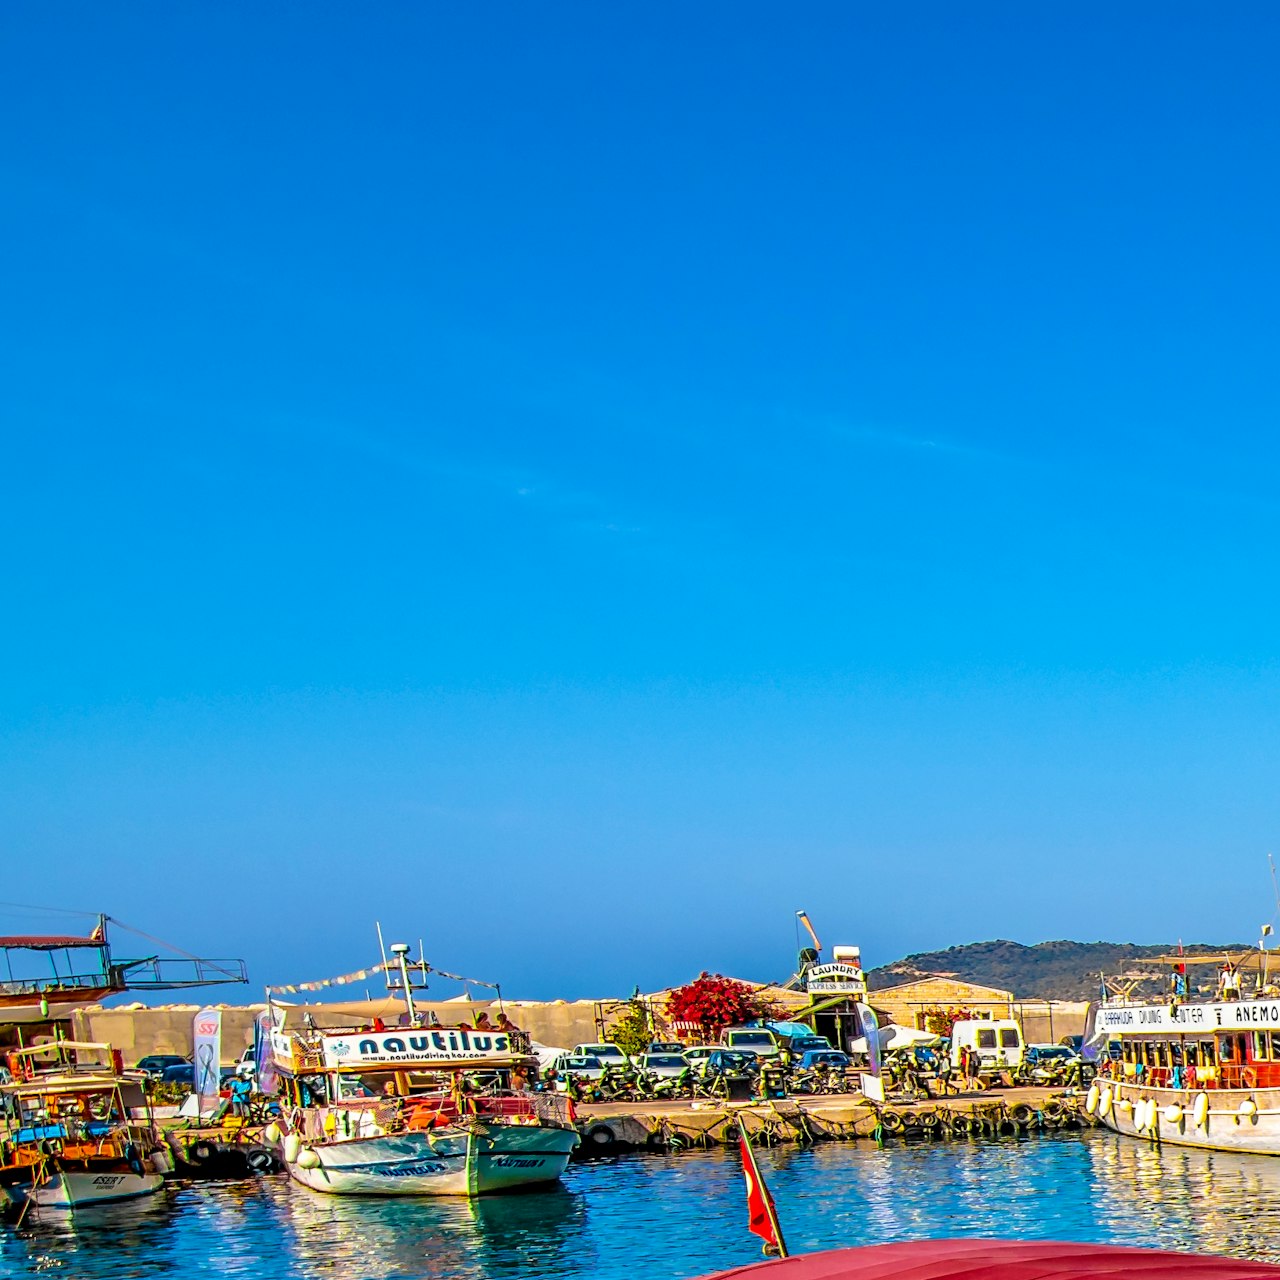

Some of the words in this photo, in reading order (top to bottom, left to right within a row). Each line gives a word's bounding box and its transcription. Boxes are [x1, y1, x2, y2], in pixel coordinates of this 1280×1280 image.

[812, 965, 859, 976] LAUNDRY
[808, 982, 837, 990] EXPRESS
[840, 982, 864, 990] SERVICE
[359, 1031, 508, 1054] nautilus
